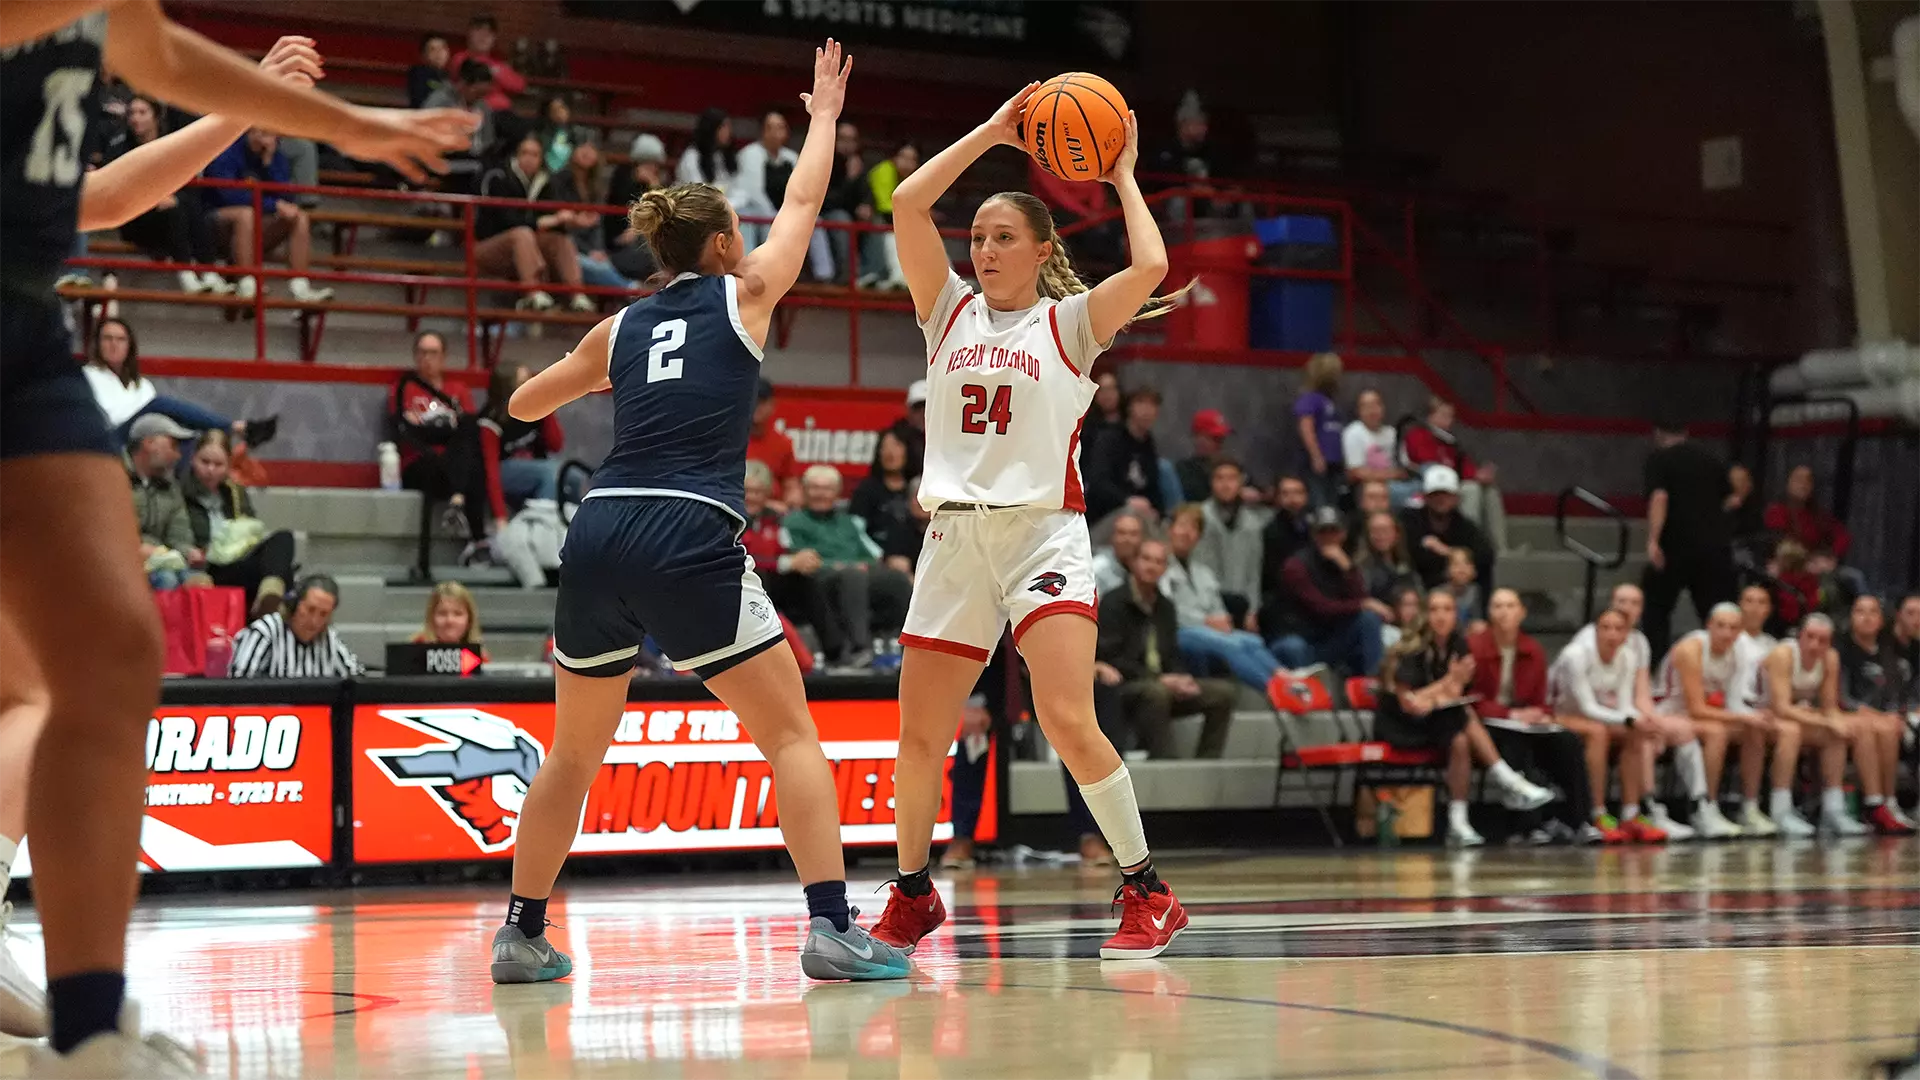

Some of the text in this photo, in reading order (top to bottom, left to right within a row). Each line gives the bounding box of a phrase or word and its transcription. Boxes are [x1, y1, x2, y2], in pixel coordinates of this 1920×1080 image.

[790, 0, 895, 29] SPORTS
[902, 6, 1027, 42] MEDICINE
[646, 318, 688, 384] 2
[961, 383, 1012, 435] 24
[647, 711, 685, 742] OF
